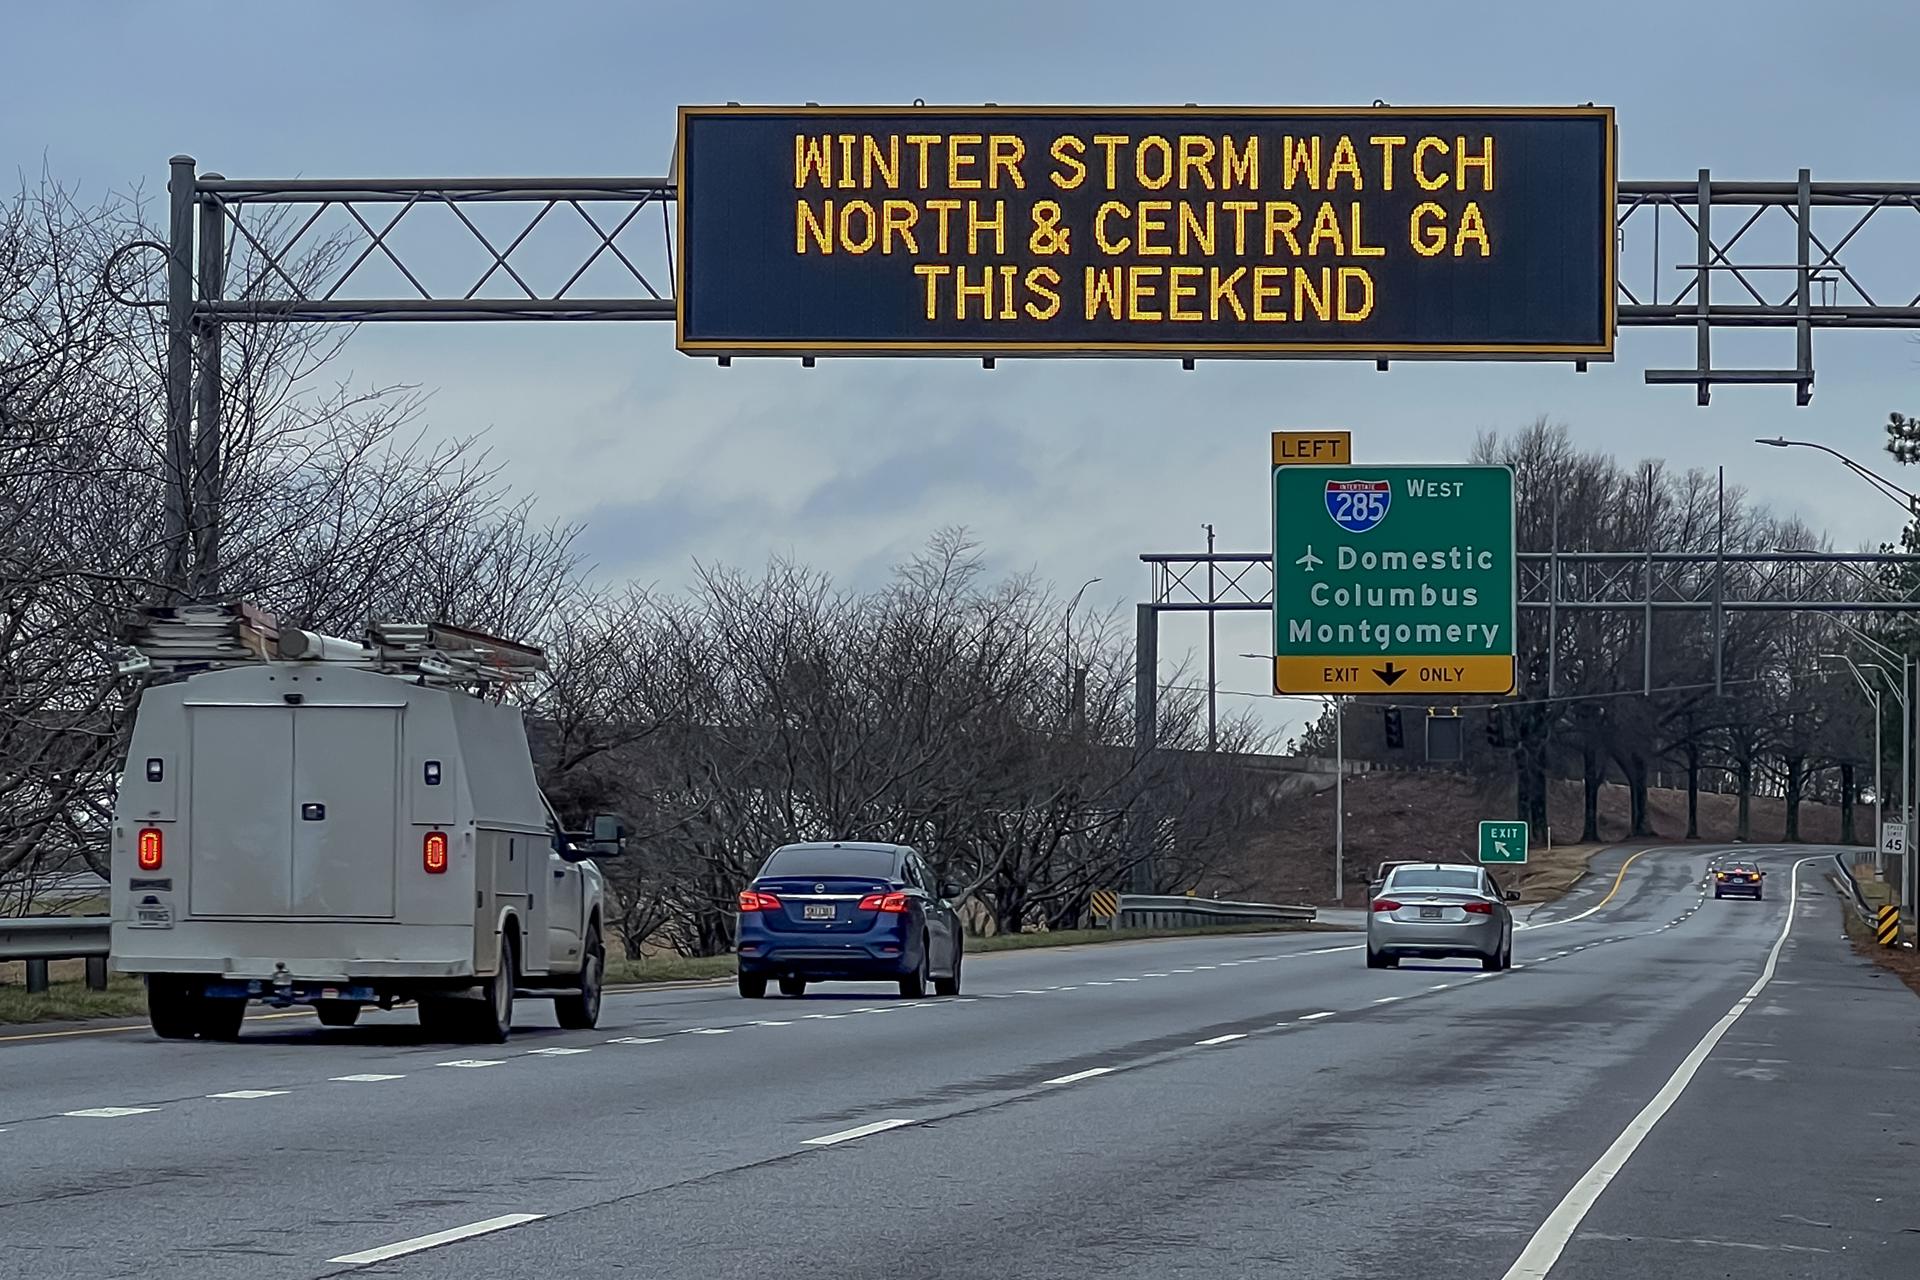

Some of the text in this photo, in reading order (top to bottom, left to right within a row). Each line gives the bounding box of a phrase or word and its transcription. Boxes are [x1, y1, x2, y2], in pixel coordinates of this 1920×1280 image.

[795, 134, 1494, 192] WINTER STORM WATCH
[796, 199, 1490, 257] NORTH & CENTRAL GA
[914, 264, 1375, 322] THIS WEEKEND
[1281, 439, 1341, 458] LEFT
[1407, 479, 1464, 497] WEST
[1336, 493, 1384, 521] 285
[1338, 546, 1493, 570] Domestic
[1311, 583, 1478, 607] Columbus
[1289, 619, 1499, 650] Montgomery
[1323, 667, 1465, 682] EXIT ONLY
[1491, 828, 1518, 838] EXIT
[1885, 838, 1902, 851] 45
